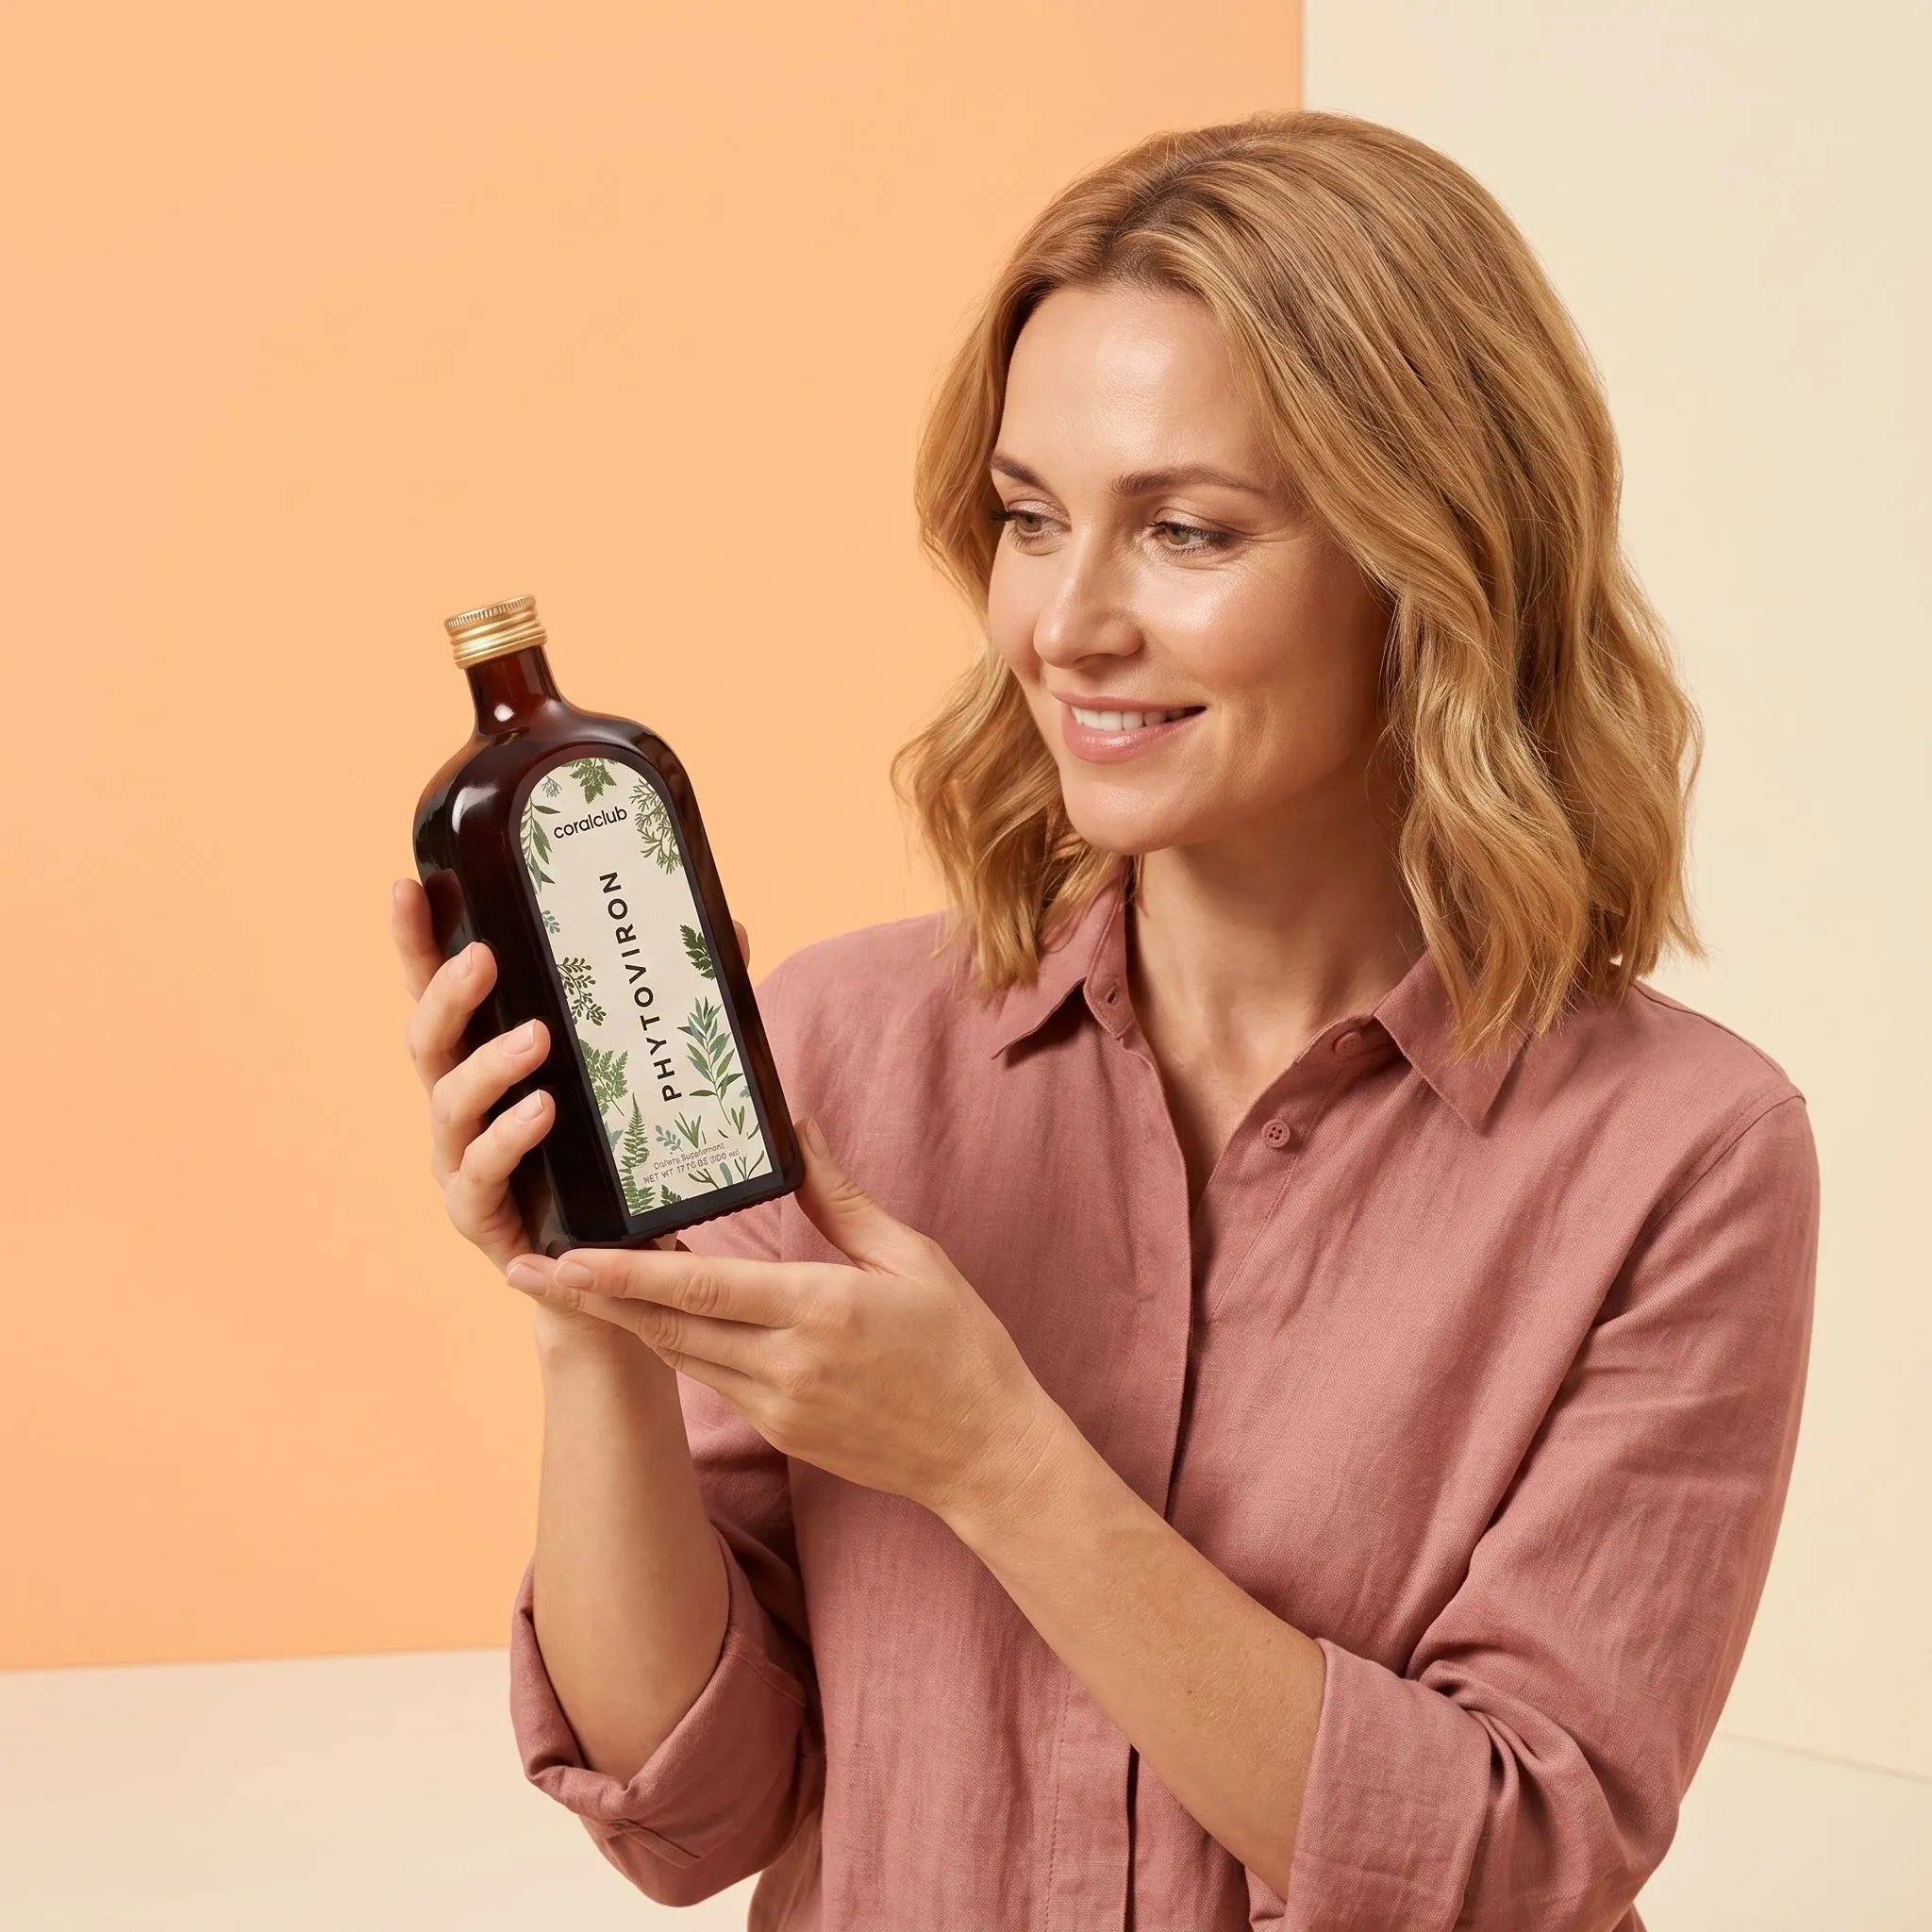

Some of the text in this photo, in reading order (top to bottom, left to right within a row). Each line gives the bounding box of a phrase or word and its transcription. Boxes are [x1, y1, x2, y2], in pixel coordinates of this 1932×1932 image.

[553, 806, 627, 839] coralclub
[599, 872, 682, 1102] PHYTOVIRON
[642, 1174, 659, 1184] NET
